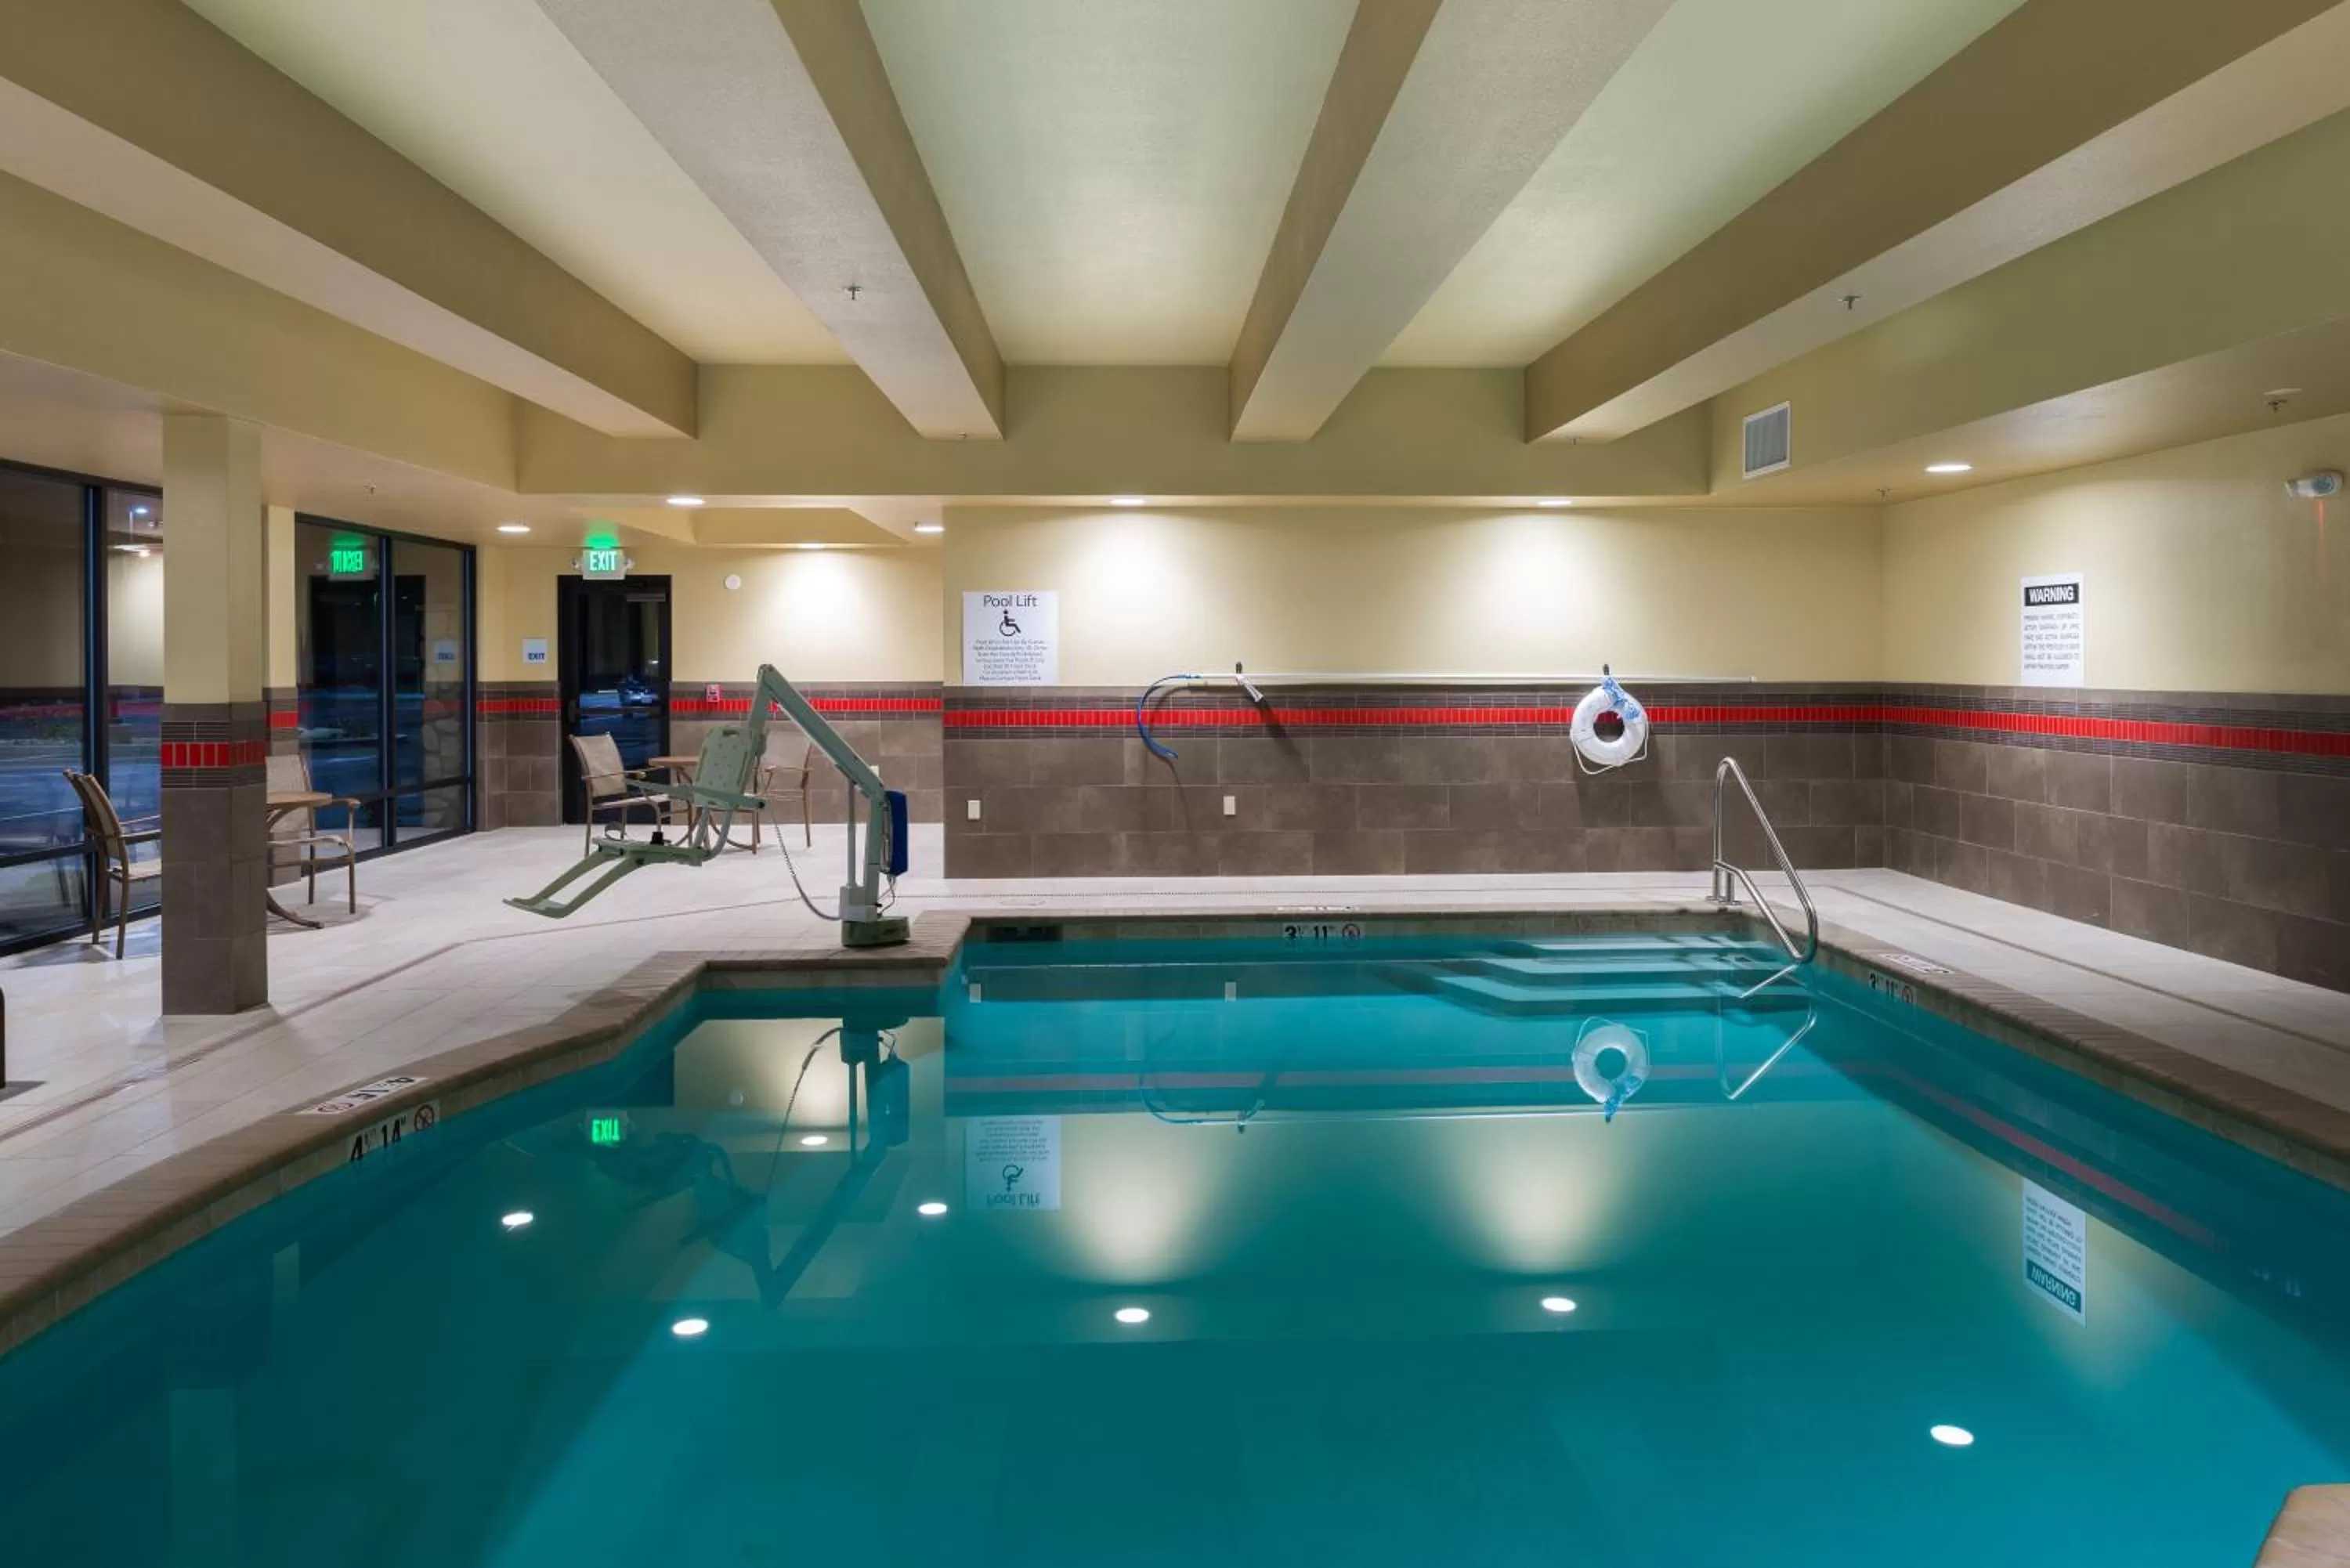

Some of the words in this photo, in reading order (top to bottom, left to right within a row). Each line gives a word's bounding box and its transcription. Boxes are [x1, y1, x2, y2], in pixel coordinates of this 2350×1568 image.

[590, 551, 617, 571] EXIT
[983, 594, 1013, 607] Pool
[1016, 594, 1038, 607] Lift
[2028, 585, 2074, 603] WARNING
